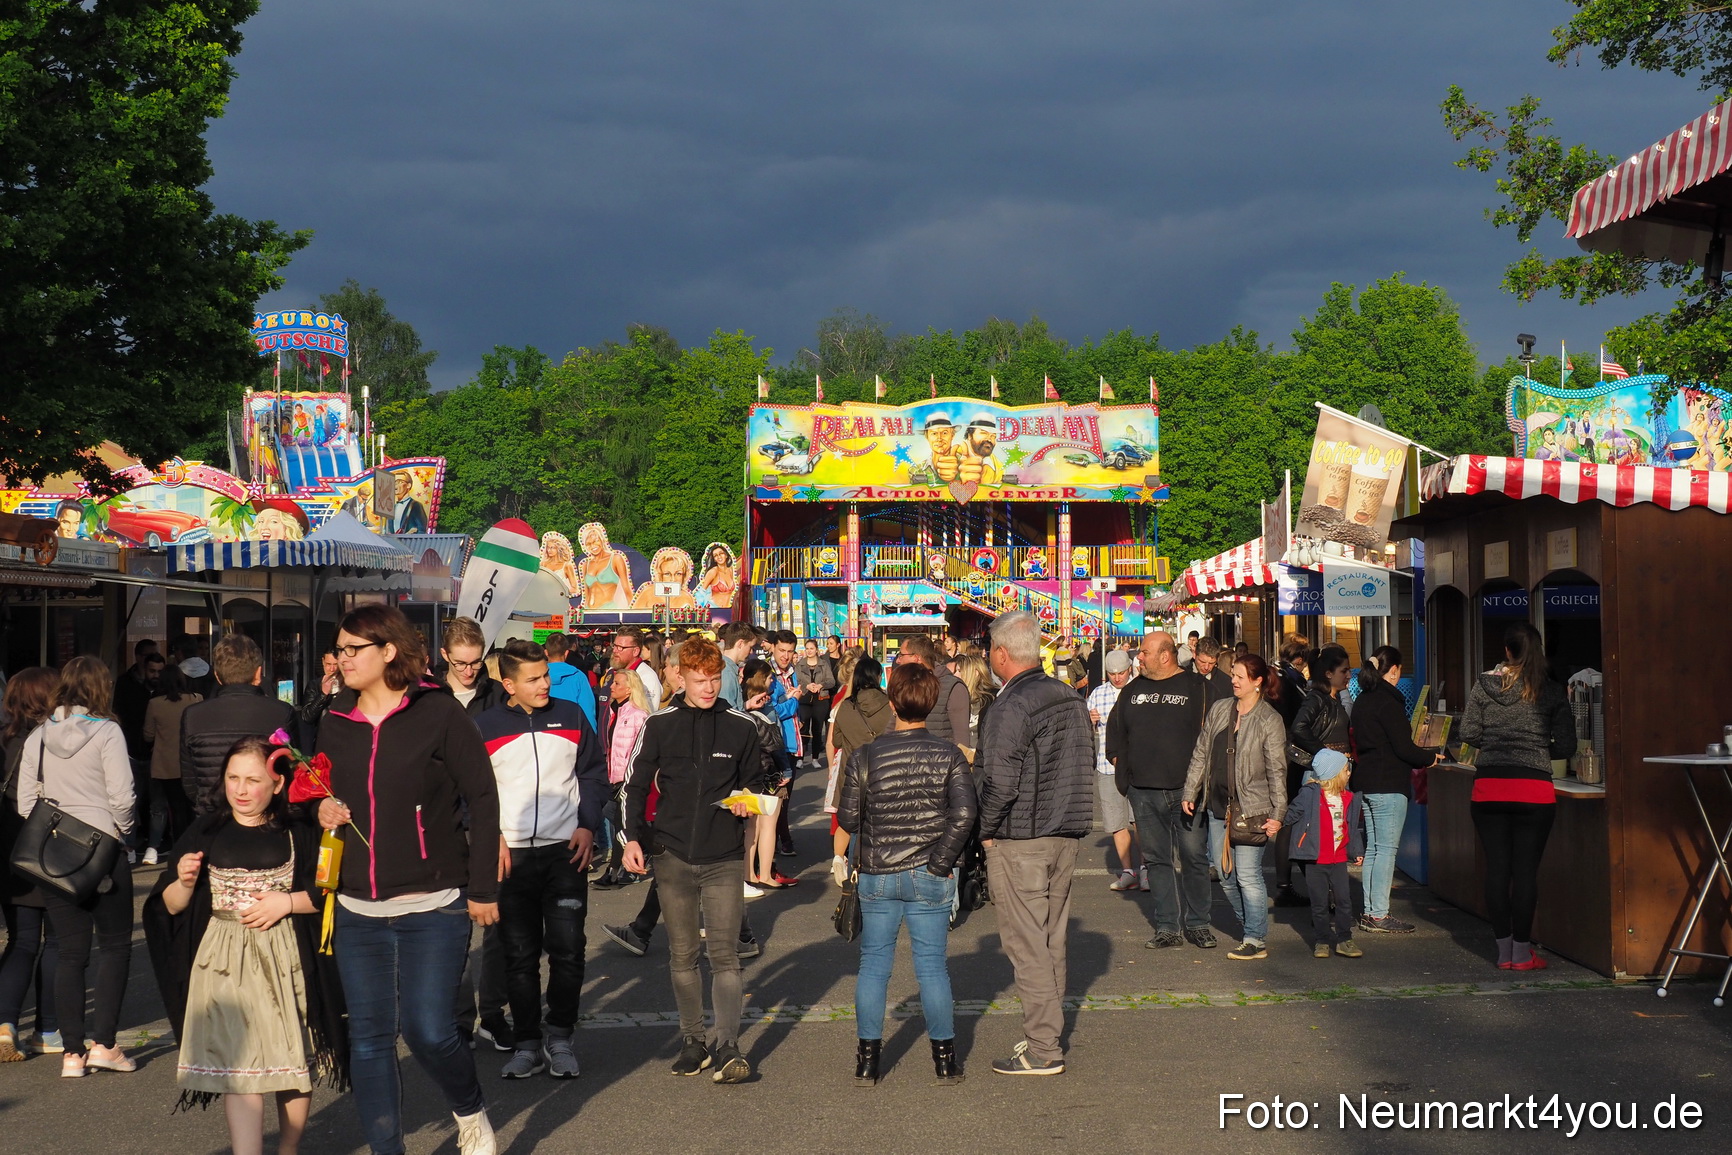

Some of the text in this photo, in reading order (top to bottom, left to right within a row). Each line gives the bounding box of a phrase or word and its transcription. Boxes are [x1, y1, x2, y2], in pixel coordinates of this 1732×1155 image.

[265, 312, 330, 329] EURO
[807, 414, 1105, 466] REMMI DEMMI
[1314, 440, 1404, 473] Coffee to go
[1325, 464, 1350, 475] Coffee
[1355, 478, 1382, 489] Coffee
[842, 487, 1088, 500] ACTION CENTER
[1358, 487, 1380, 498] to go
[1326, 572, 1387, 590] RESTAURANT
[1294, 601, 1323, 612] PITA
